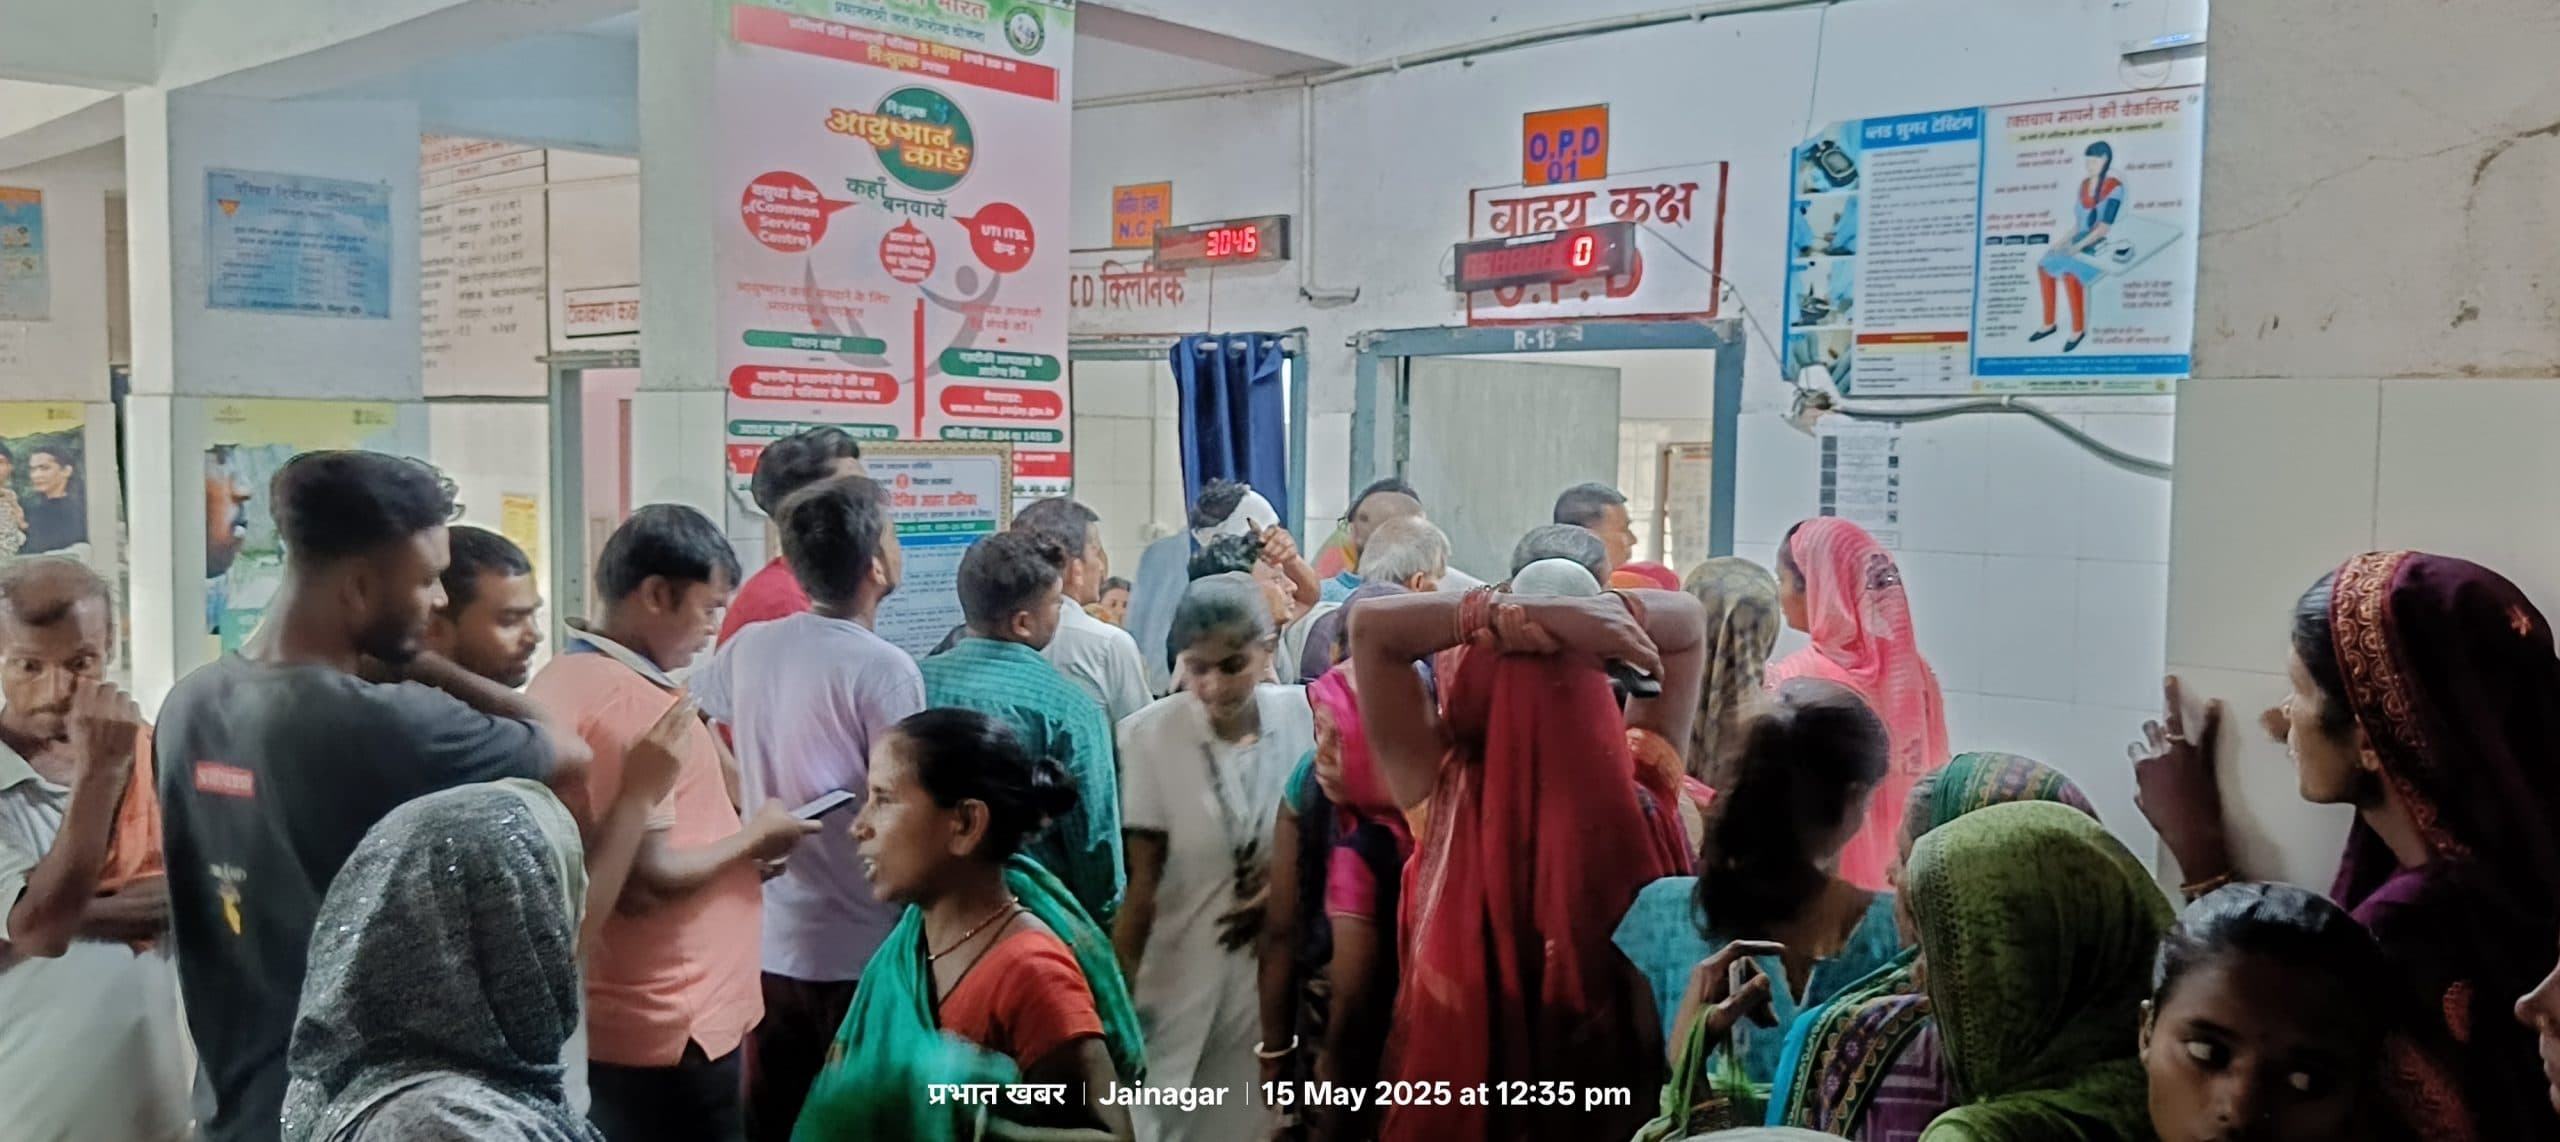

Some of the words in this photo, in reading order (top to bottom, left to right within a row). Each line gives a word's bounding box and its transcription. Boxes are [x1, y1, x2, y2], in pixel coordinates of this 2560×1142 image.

[938, 0, 986, 20] भारत
[2097, 99, 2118, 120] की
[2121, 96, 2181, 118] चेकलिस्ट
[827, 108, 952, 148] आयुष्मान
[1896, 120, 1928, 141] शुगर
[1931, 113, 1975, 134] टेस्टिंग
[1529, 126, 1601, 163] O.P.D
[903, 146, 969, 172] कार्ड
[1546, 160, 1579, 186] 01
[846, 176, 887, 200] कहाँ
[751, 199, 820, 218] (Common
[882, 197, 947, 219] बनवायें
[1608, 182, 1699, 229] कक्ष
[759, 217, 811, 234] Service
[1206, 226, 1257, 257] 3046
[1572, 236, 1593, 267] 0
[1070, 274, 1094, 308] CD
[1099, 259, 1187, 312] क्लिनिक
[1513, 330, 1557, 351] R-13
